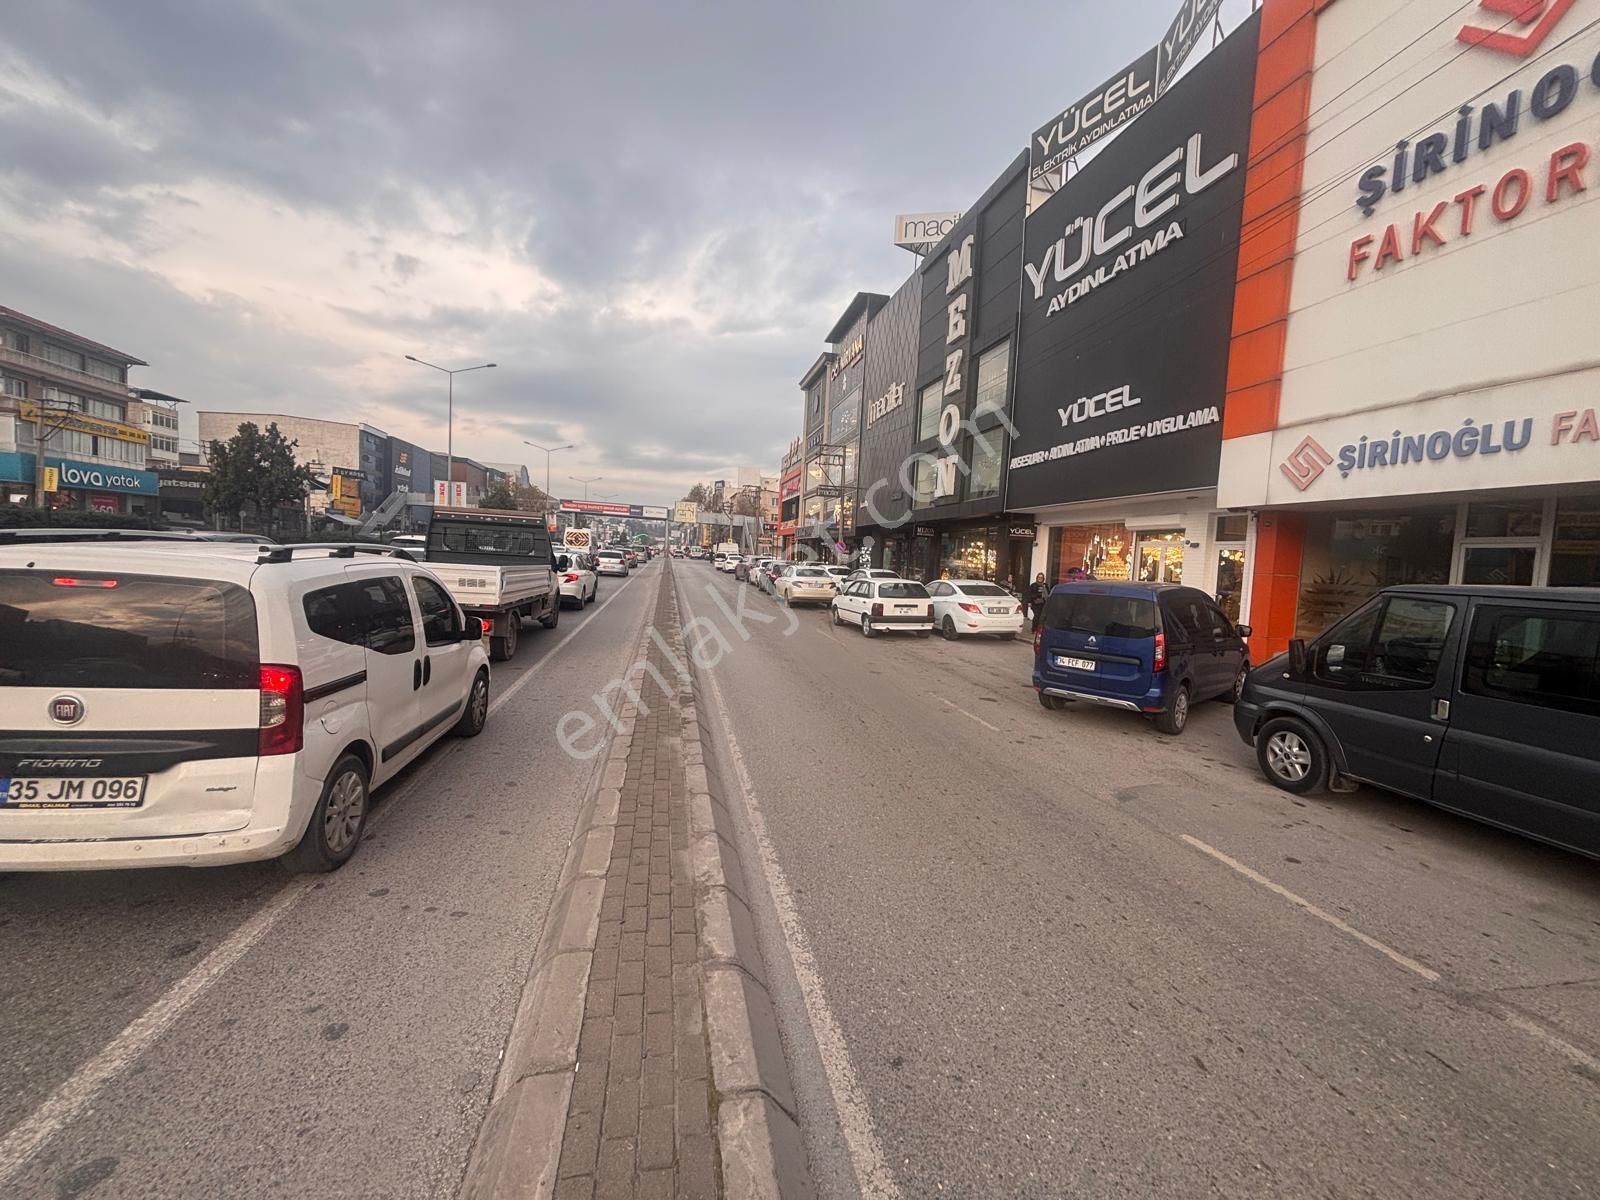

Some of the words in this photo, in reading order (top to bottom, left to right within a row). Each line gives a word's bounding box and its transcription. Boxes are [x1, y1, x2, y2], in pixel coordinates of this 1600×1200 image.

[1165, 0, 1207, 62] YÜ
[1032, 142, 1078, 178] ELEKTRİK
[1078, 94, 1153, 149] AYDINLATMA
[1037, 71, 1150, 156] YÜCEL
[1355, 50, 1600, 218] ŞİRİNO
[1024, 133, 1239, 299] YÜCEL
[1347, 141, 1591, 281] FAKTOR
[1046, 220, 1184, 317] AYDINLATMA
[934, 234, 975, 499] MEZON
[1057, 384, 1142, 427] YÜCEL
[1105, 425, 1142, 446] PROJE
[1146, 406, 1220, 437] UYGULAMA
[60, 462, 103, 486] lova
[106, 475, 141, 488] yatak
[1337, 417, 1534, 478] ŞİRİNOĞLU
[1009, 526, 1035, 535] YÜCEL
[56, 704, 76, 717] FIAT
[8, 780, 39, 800] 35
[47, 780, 84, 800] JM
[92, 779, 138, 800] 096
